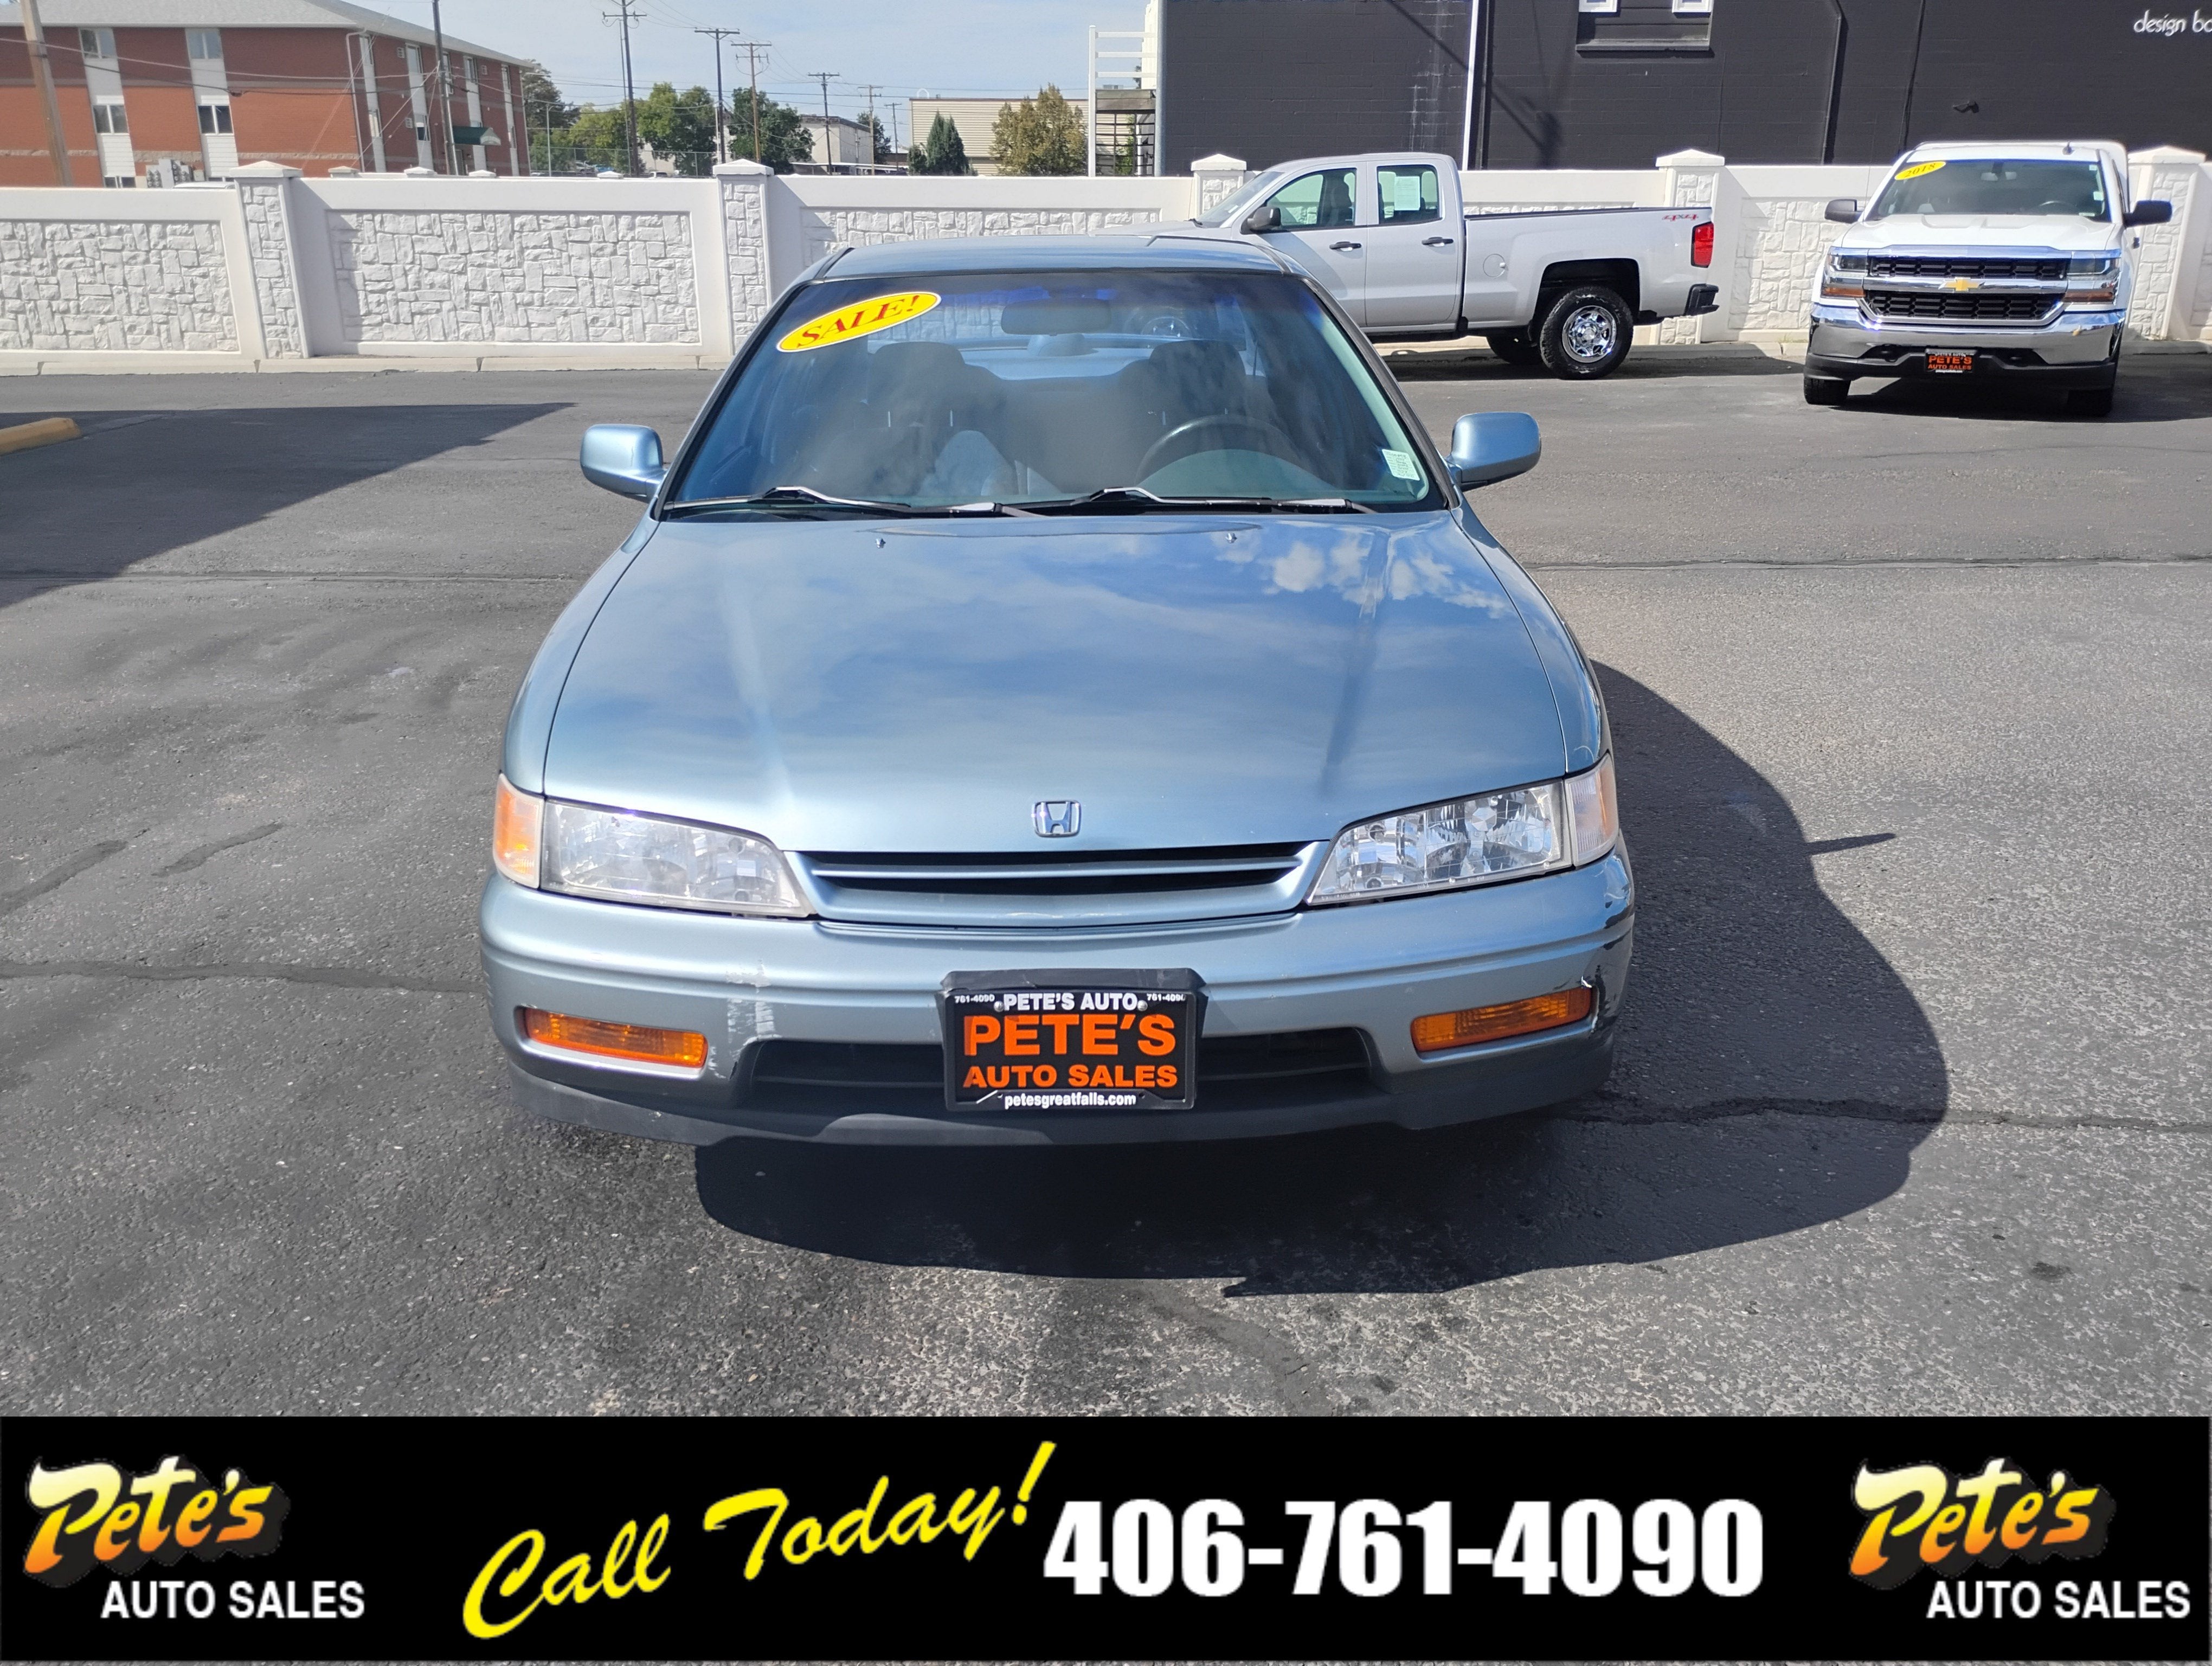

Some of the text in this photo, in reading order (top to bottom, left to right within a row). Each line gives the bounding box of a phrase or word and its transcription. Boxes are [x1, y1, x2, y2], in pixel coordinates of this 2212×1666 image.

[2133, 9, 2187, 36] design
[1904, 163, 1936, 177] 2018
[797, 295, 920, 348] SALE!
[1928, 355, 1972, 364] PETE'S
[954, 994, 995, 1003] 761-4090
[1003, 992, 1138, 1011] PETE'S AUTO
[963, 1014, 1176, 1056] PETE'S
[963, 1065, 1178, 1088] AUTO SALES
[1005, 1092, 1136, 1110] petesgreatfalls.com
